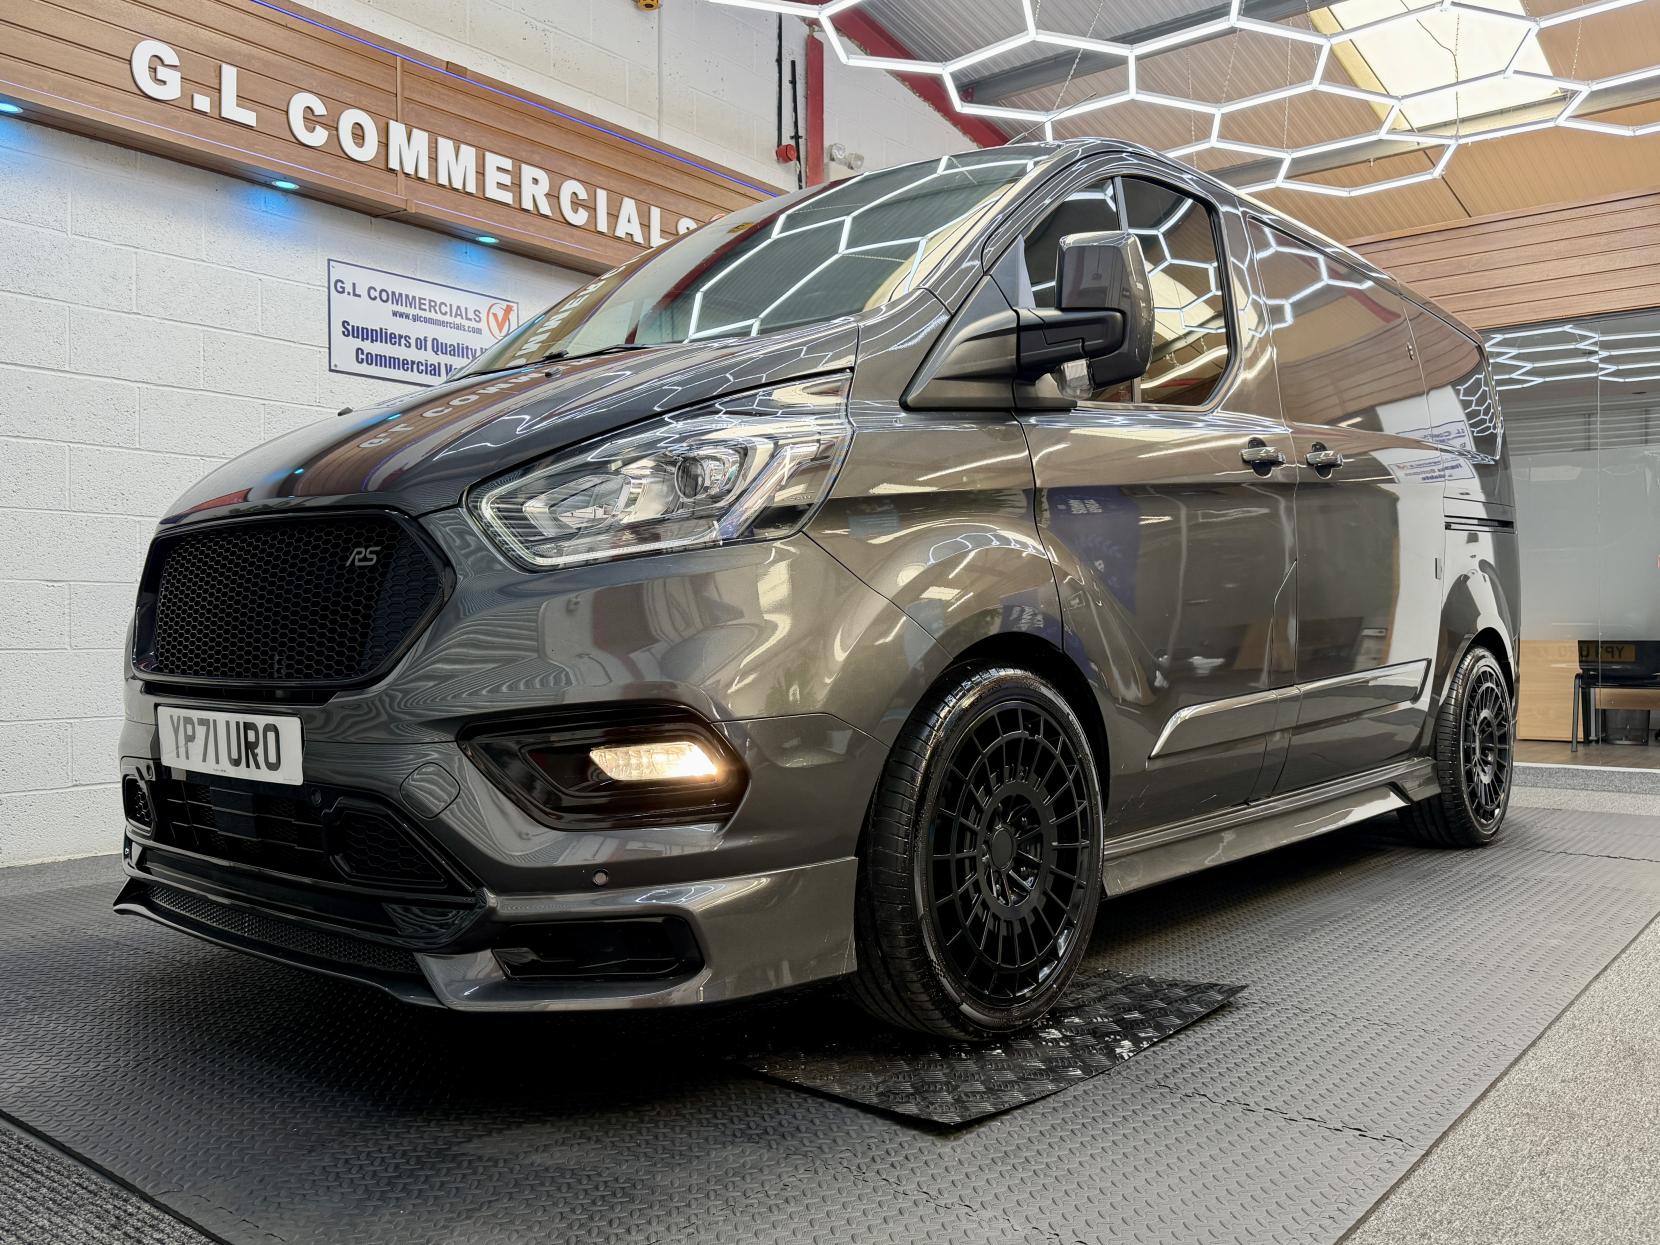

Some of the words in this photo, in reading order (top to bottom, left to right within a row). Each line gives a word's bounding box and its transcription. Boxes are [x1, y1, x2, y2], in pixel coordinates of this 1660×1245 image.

[131, 39, 257, 128] G.L
[333, 279, 362, 299] G.L
[366, 286, 482, 324] COMMERCIALS
[341, 320, 412, 349] Suppliers
[415, 336, 429, 352] of
[431, 337, 478, 361] Quality
[391, 309, 483, 336] www.glcommercials.com
[355, 347, 442, 378] Commercial
[345, 546, 382, 567] RS
[169, 714, 220, 765] YP71
[225, 719, 281, 771] URO
